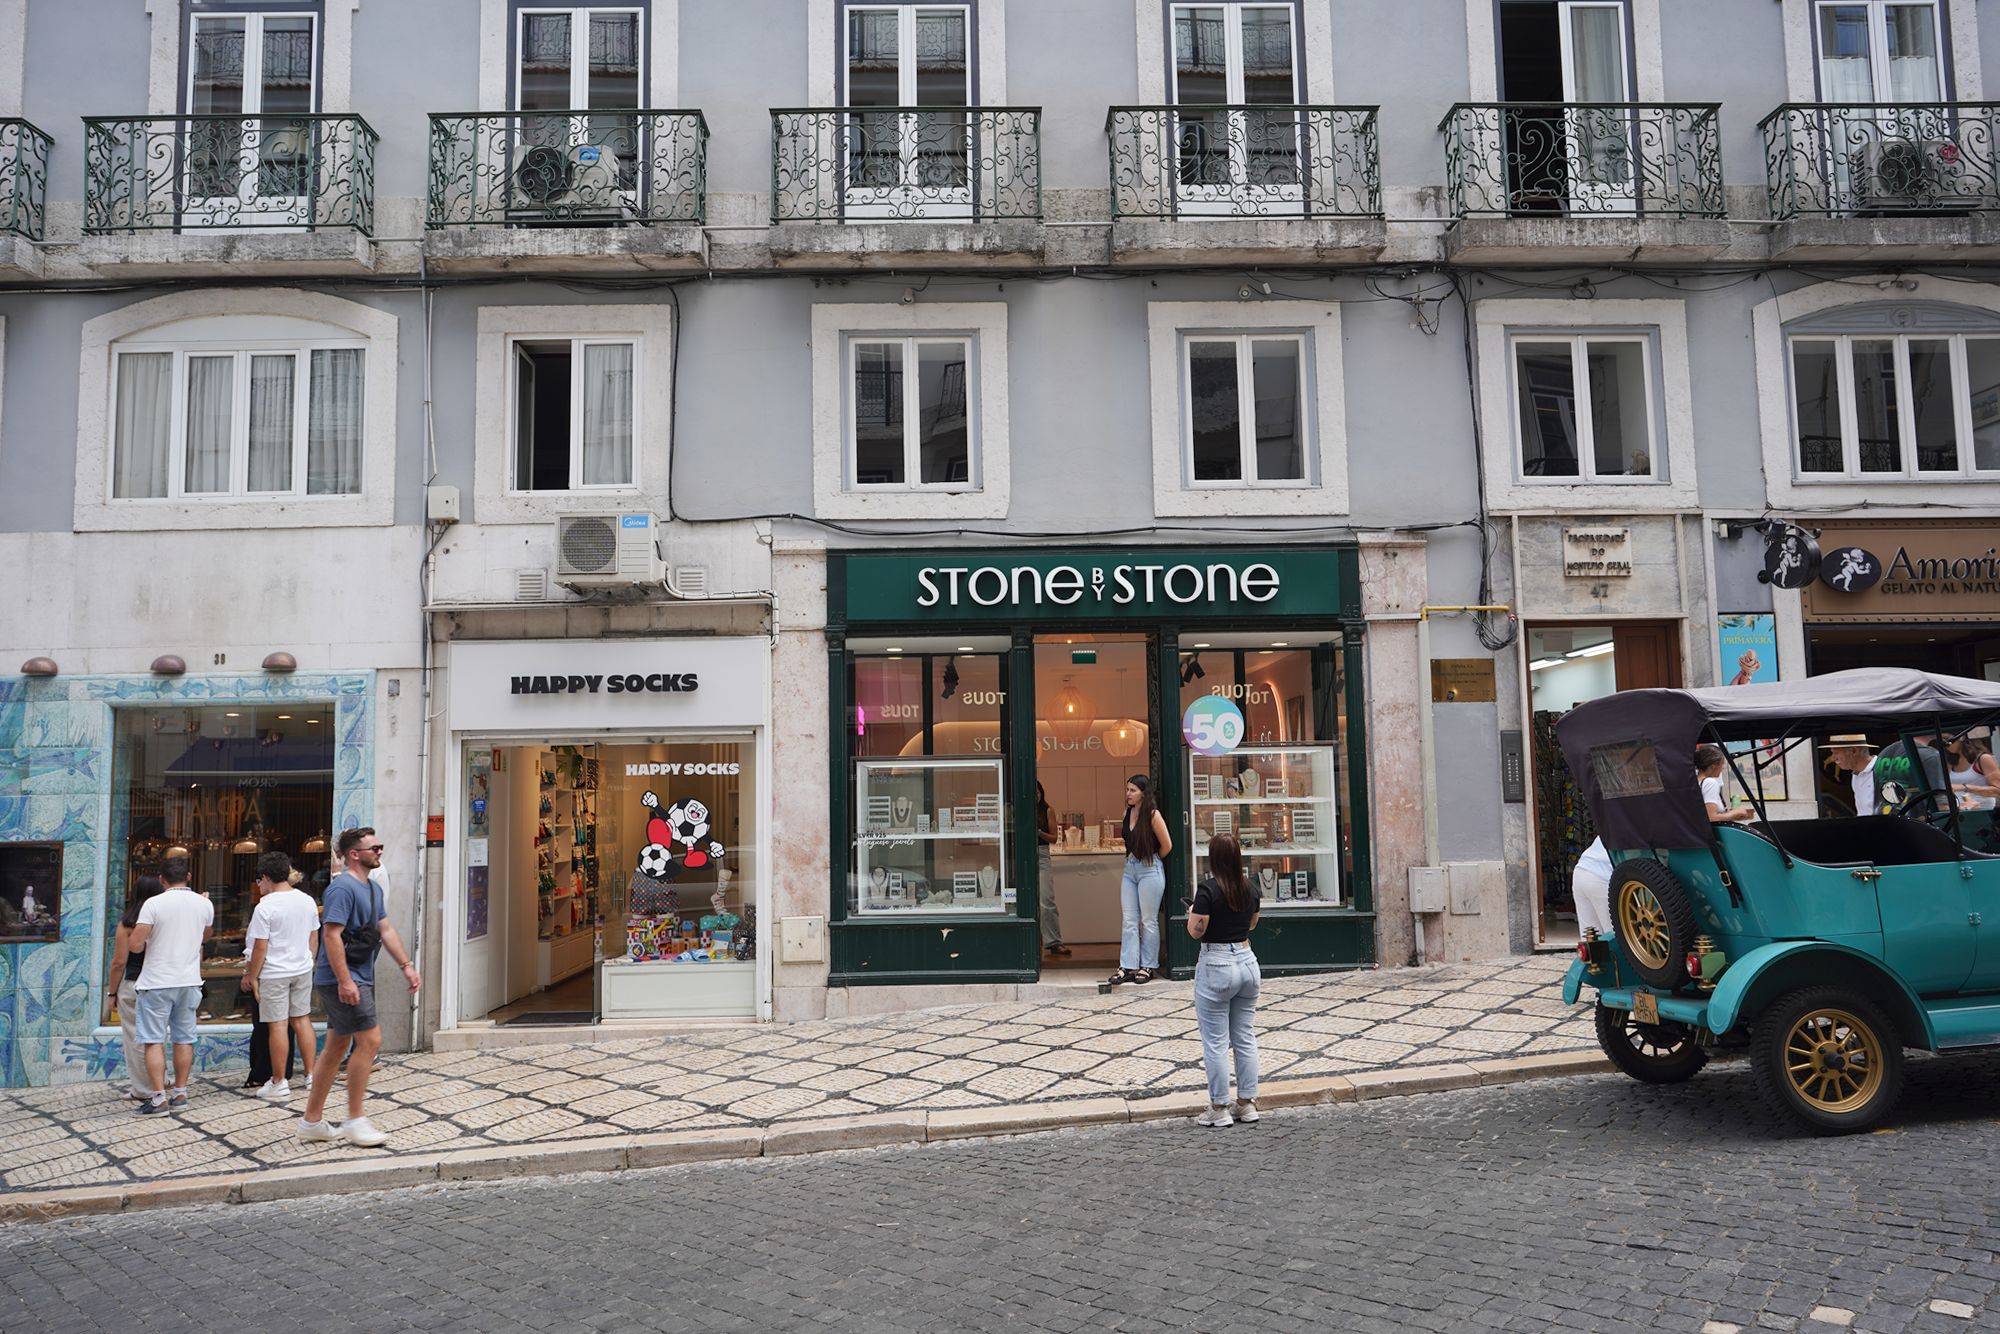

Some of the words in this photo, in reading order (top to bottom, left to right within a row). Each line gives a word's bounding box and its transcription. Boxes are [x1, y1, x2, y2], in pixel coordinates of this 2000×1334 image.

[1592, 548, 1605, 556] DO
[1606, 561, 1631, 570] GERAL
[1883, 546, 2000, 580] Amori
[1881, 583, 1936, 594] GELATO
[1941, 583, 1958, 594] AL
[511, 675, 603, 694] HAPPY
[607, 673, 698, 693] SOCKS
[626, 764, 681, 776] HAPPY
[684, 763, 740, 775] SOCKS
